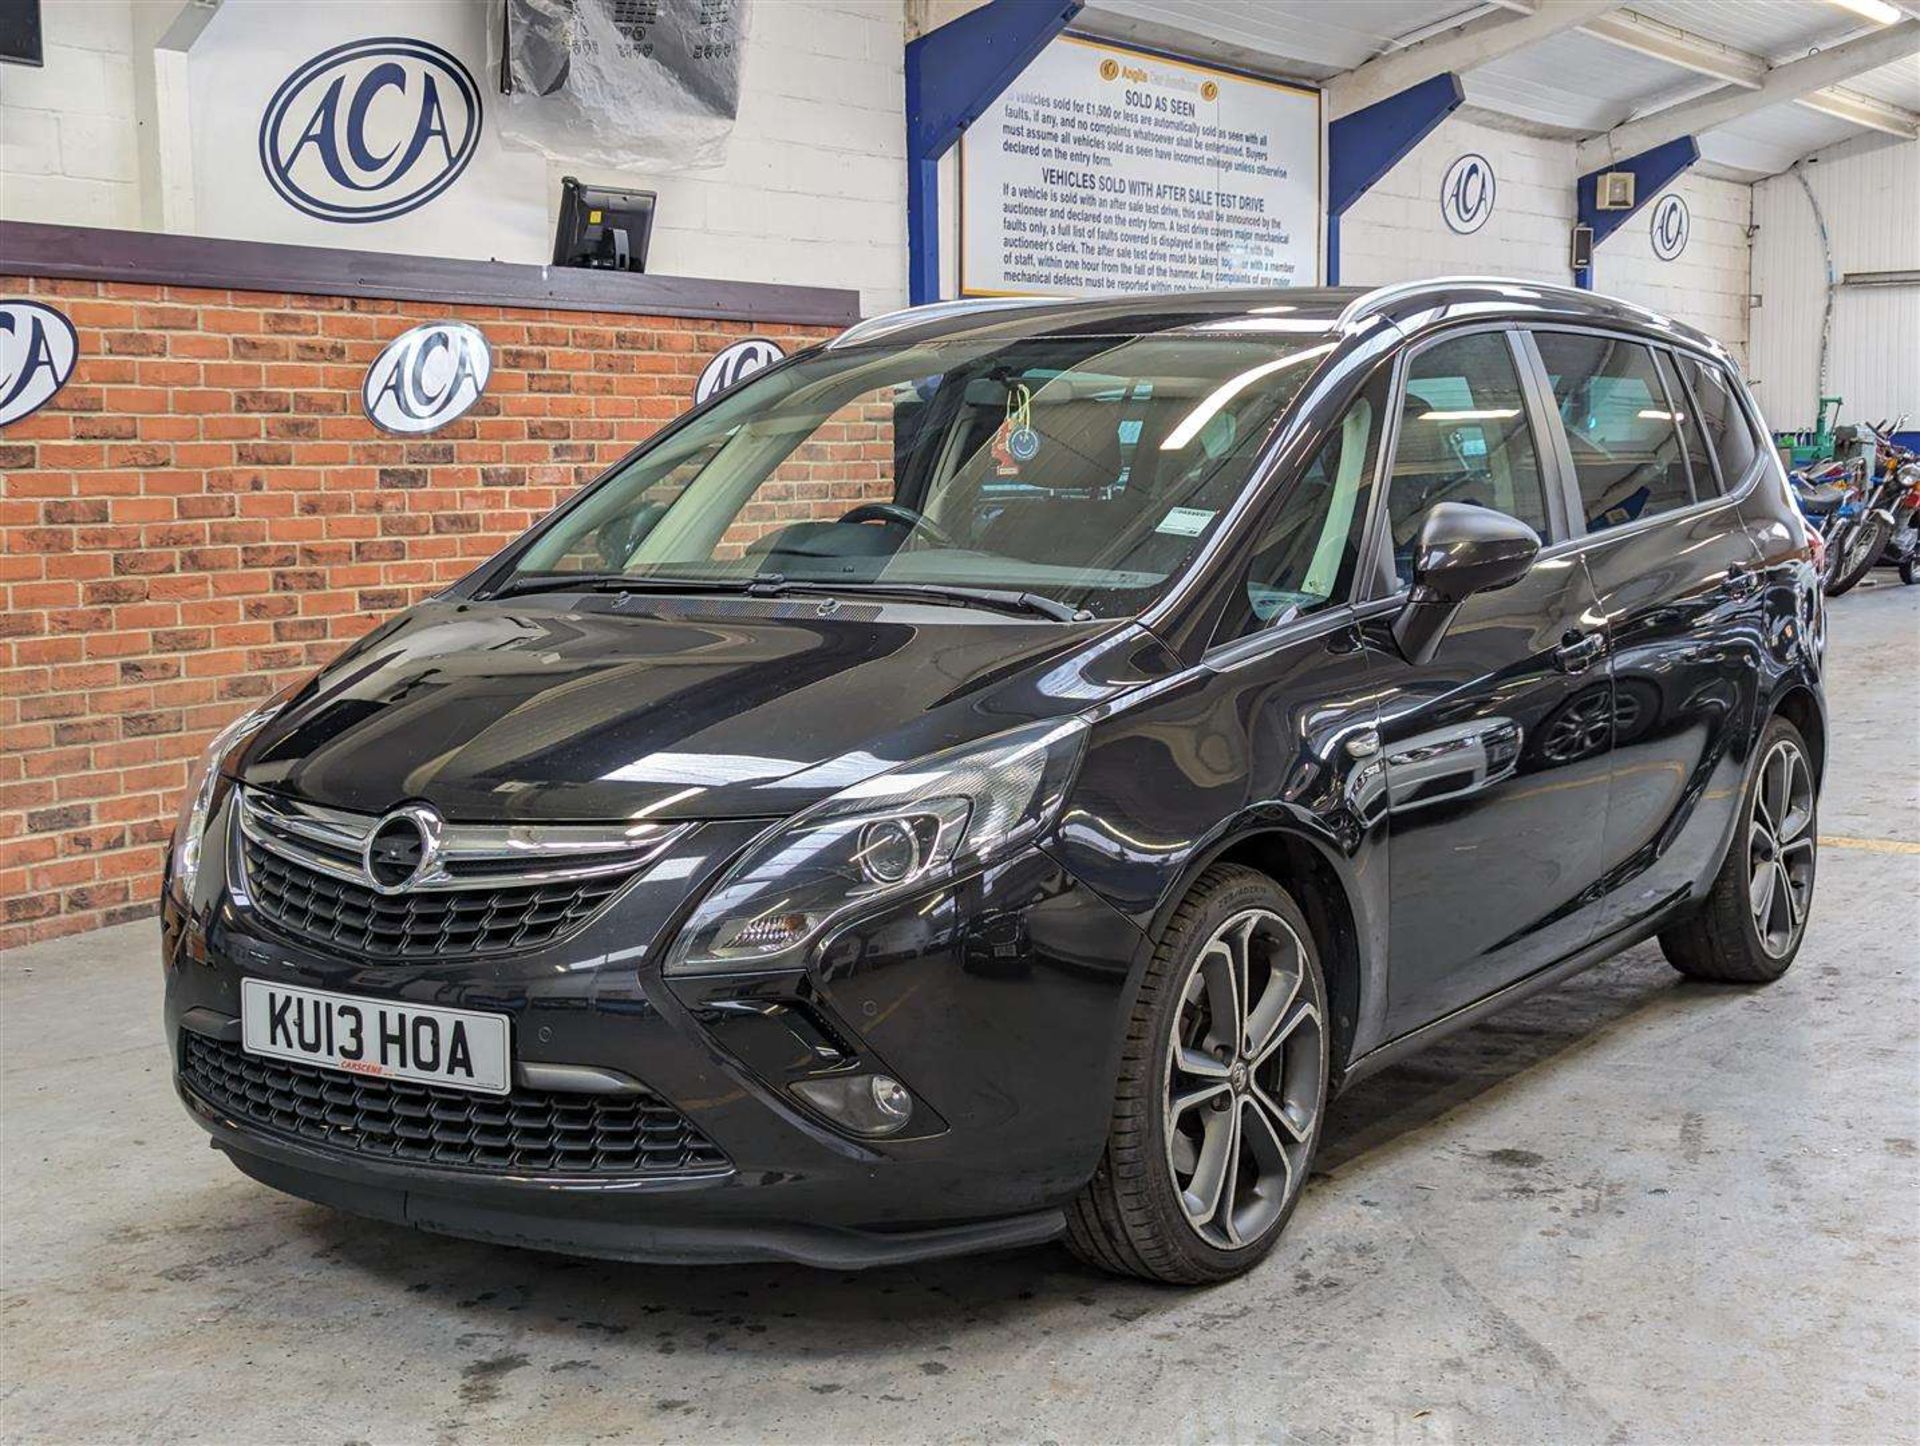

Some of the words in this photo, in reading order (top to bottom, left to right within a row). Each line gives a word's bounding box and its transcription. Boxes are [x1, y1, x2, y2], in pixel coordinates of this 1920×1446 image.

[1053, 99, 1070, 111] sold
[1073, 100, 1084, 113] for
[1086, 104, 1112, 118] £1,500
[1113, 110, 1122, 120] or
[1123, 110, 1138, 123] less
[1141, 115, 1151, 125] are
[1154, 117, 1200, 137] automatically
[1202, 126, 1217, 137] sold
[1218, 130, 1226, 139] as
[1229, 131, 1243, 141] seen
[1245, 131, 1258, 144] with
[1126, 89, 1152, 109] SOLD
[1155, 96, 1167, 112] AS
[1171, 99, 1195, 117] SEEN
[283, 62, 453, 191] ACA
[1005, 105, 1031, 122] faults,
[1034, 110, 1039, 121] if
[1060, 116, 1076, 128] and
[1078, 120, 1088, 130] no
[1090, 122, 1131, 138] complaints
[1133, 128, 1174, 145] whatsoever
[1177, 136, 1193, 148] shall
[1195, 139, 1204, 149] be
[1246, 147, 1267, 161] Buyers
[1003, 125, 1024, 137] must
[1027, 127, 1059, 142] assume
[1061, 133, 1071, 144] all
[1073, 135, 1105, 150] vehicles
[1108, 141, 1123, 152] sold
[1126, 144, 1134, 154] as
[1136, 146, 1153, 157] seen
[1155, 147, 1171, 161] have
[1174, 151, 1205, 165] incorrect
[1206, 155, 1233, 172] mileage
[1235, 161, 1255, 174] unless
[1257, 165, 1287, 178] otherwise
[1003, 140, 1040, 156] declared
[1042, 148, 1053, 158] on
[1055, 148, 1068, 160] the
[1070, 151, 1090, 166] entry
[1093, 153, 1112, 166] form.
[1003, 183, 1009, 195] If
[1012, 187, 1016, 197] a
[1019, 186, 1048, 200] vehicle
[1051, 190, 1057, 201] is
[1060, 192, 1077, 204] sold
[1080, 194, 1097, 205] with
[1098, 198, 1108, 208] an
[1110, 198, 1126, 210] after
[1129, 201, 1143, 212] sale
[1145, 203, 1159, 214] test
[1182, 207, 1195, 219] this
[1198, 209, 1215, 221] shall
[1216, 211, 1224, 221] be
[1226, 214, 1261, 228] announced
[1263, 217, 1270, 230] by
[1271, 218, 1281, 229] the
[1042, 168, 1096, 189] VEHICLES
[1099, 176, 1126, 193] SOLD
[1128, 179, 1152, 197] WITH
[1156, 185, 1186, 200] AFTER
[1188, 188, 1212, 205] SALE
[1215, 192, 1236, 209] TEST
[1239, 195, 1264, 212] DRIVE
[1446, 163, 1488, 223] ACA
[1003, 202, 1047, 217] auctioneer
[1050, 207, 1064, 219] and
[1067, 209, 1100, 223] declared
[1103, 214, 1113, 224] on
[1115, 215, 1126, 225] the
[1128, 217, 1147, 231] entry
[1149, 218, 1167, 231] form.
[1169, 220, 1175, 231] A
[1177, 221, 1190, 233] test
[1192, 223, 1209, 236] drive
[1211, 226, 1233, 238] covers
[1235, 228, 1253, 242] major
[1255, 231, 1289, 244] mechanical
[1003, 218, 1026, 232] faults
[1051, 226, 1056, 235] a
[1058, 224, 1071, 236] full
[1073, 225, 1085, 237] list
[1087, 228, 1096, 238] of
[1097, 228, 1118, 241] faults
[1120, 230, 1149, 245] covered
[1151, 234, 1157, 245] is
[1159, 235, 1193, 251] displayed
[1196, 240, 1201, 249] in
[1203, 239, 1213, 250] the
[1654, 202, 1684, 251] ACA
[1003, 253, 1012, 264] of
[1038, 256, 1062, 269] within
[1065, 259, 1080, 269] one
[1081, 259, 1100, 271] hour
[1101, 260, 1119, 273] from
[1120, 261, 1132, 274] the
[1134, 263, 1145, 275] fall
[1147, 264, 1155, 276] of
[1156, 265, 1167, 276] the
[1201, 269, 1213, 283] Any
[1216, 269, 1251, 285] complaints
[1252, 274, 1259, 285] of
[1261, 274, 1271, 287] any
[1004, 270, 1051, 284] mechanical
[1053, 271, 1084, 287] defects
[1085, 274, 1104, 288] must
[1106, 277, 1115, 288] be
[1056, 241, 1078, 254] clerk.
[1081, 242, 1095, 255] The
[1098, 243, 1115, 256] after
[1117, 245, 1132, 259] sale
[1134, 246, 1147, 260] test
[1149, 248, 1167, 262] drive
[1168, 251, 1187, 263] must
[1188, 254, 1197, 264] be
[1251, 258, 1263, 271] with
[1270, 261, 1295, 273] member
[371, 331, 483, 419] ACA
[268, 991, 363, 1061] KU13
[379, 1010, 474, 1078] HOA
